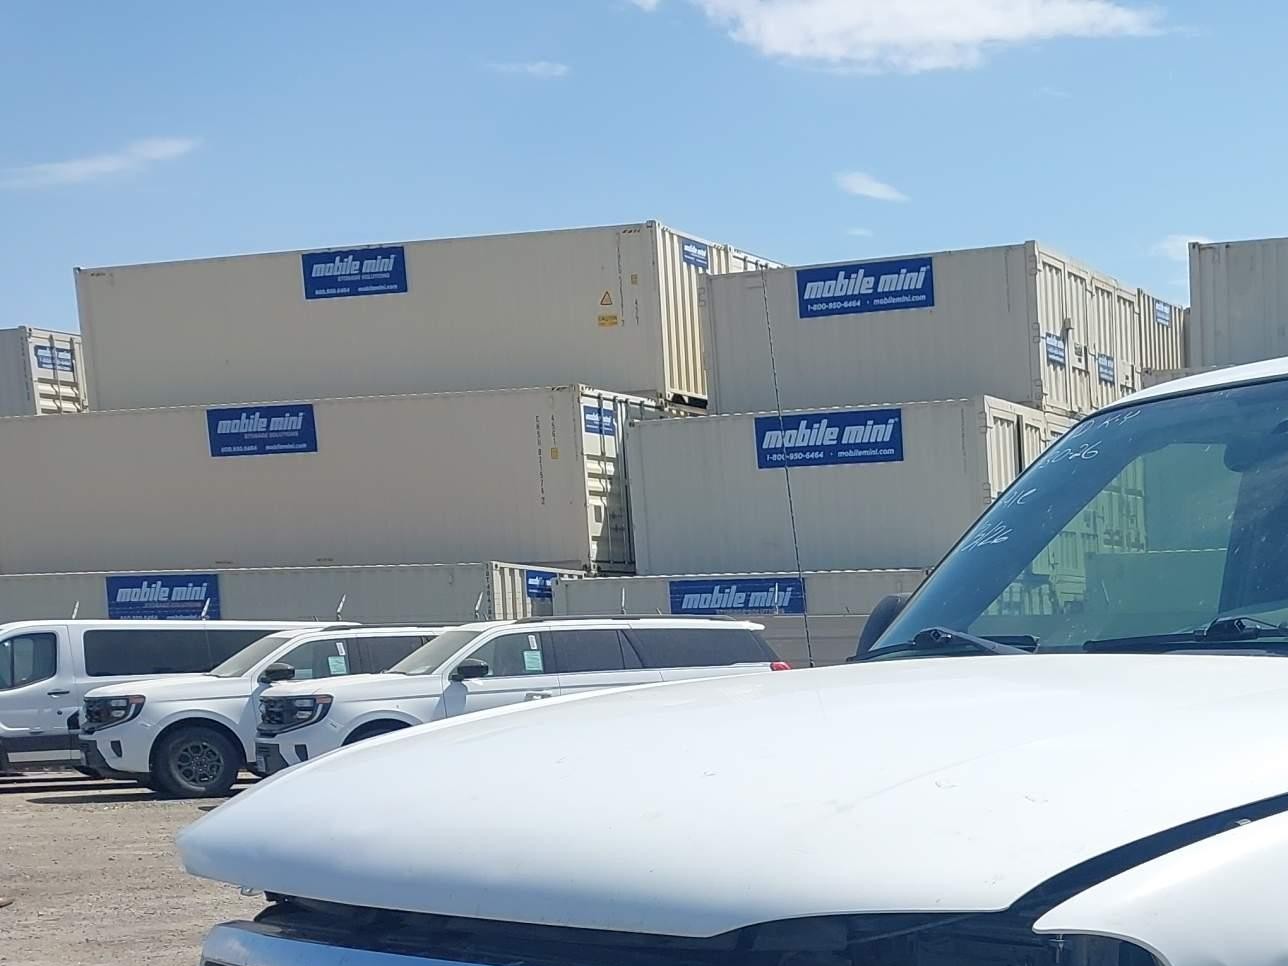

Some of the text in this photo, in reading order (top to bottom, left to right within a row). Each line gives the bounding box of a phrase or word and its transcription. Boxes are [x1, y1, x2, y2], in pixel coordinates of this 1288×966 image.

[312, 255, 396, 277] mobile mini
[804, 266, 927, 299] mobile mini
[808, 295, 926, 311] 1-800-950-6464 mobilemini.com
[217, 412, 304, 433] mobile mini
[762, 418, 895, 448] mobile mini
[838, 447, 895, 458] mobilemini.com
[116, 581, 208, 602] mobile mini
[682, 585, 746, 609] mobile
